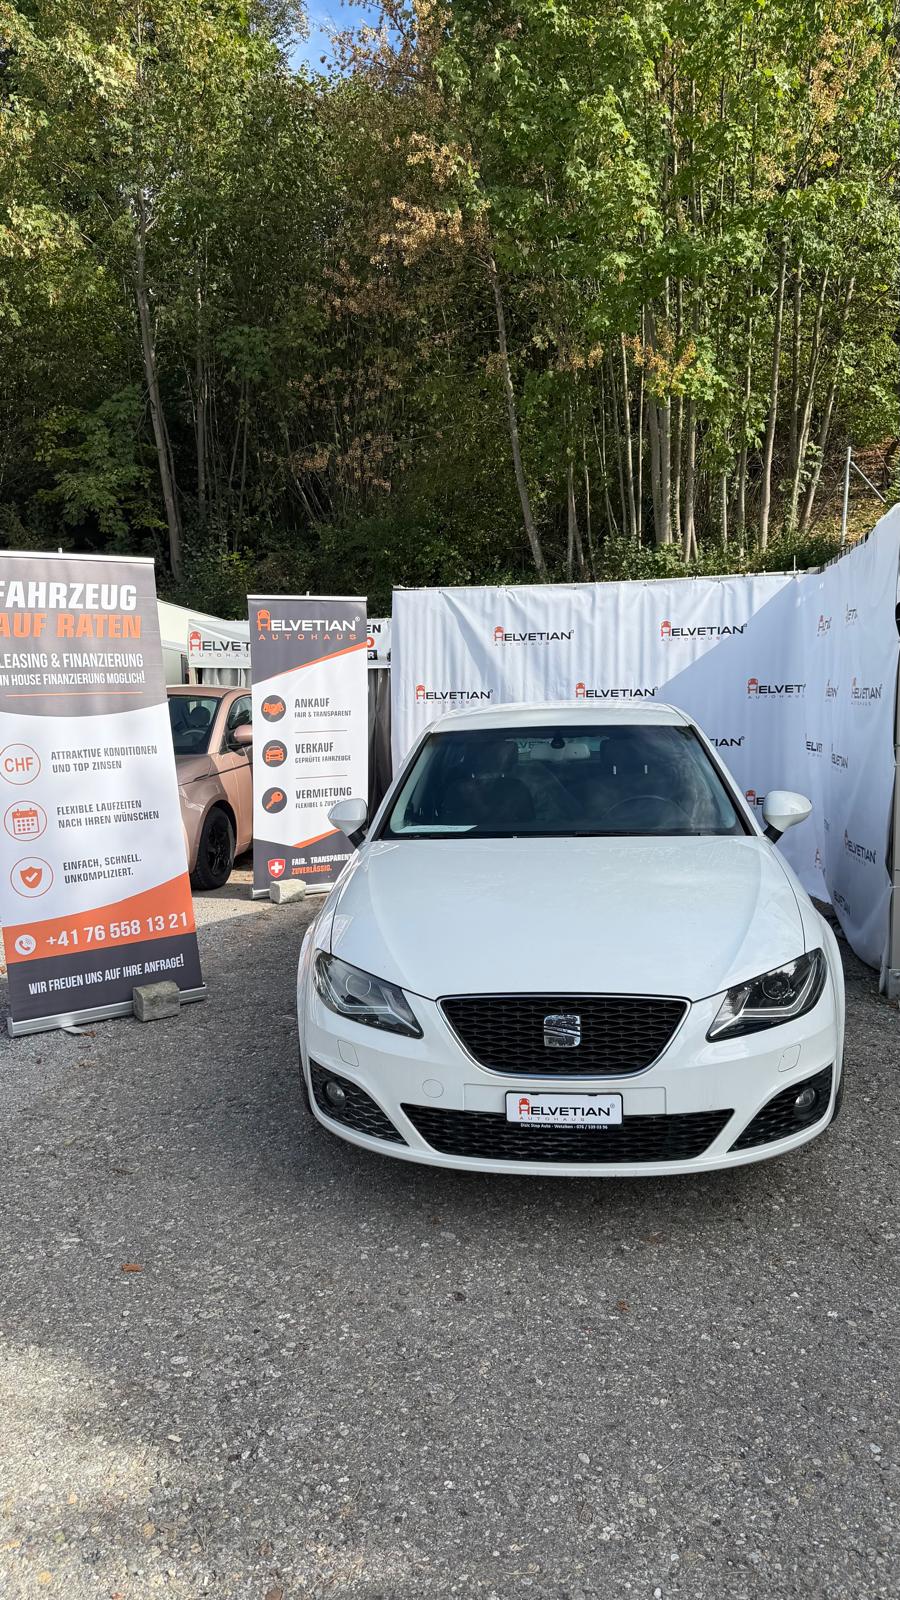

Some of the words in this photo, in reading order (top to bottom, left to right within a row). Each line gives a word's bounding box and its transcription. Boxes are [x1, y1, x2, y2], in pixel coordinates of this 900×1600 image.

[56, 613, 142, 639] RATEN
[189, 630, 251, 651] HELVET
[258, 633, 357, 641] AUTOHAUS
[51, 653, 60, 668] &
[63, 653, 144, 668] FINANZIERUNG
[11, 674, 41, 686] HOUSE
[43, 672, 105, 685] FINANZIERUNG
[294, 698, 330, 708] ANKAUF
[313, 710, 351, 718] TRANSPARENT
[51, 747, 101, 760] ATTRAKTIVE
[103, 745, 158, 757] KONDITIONEN
[295, 742, 334, 753] VERKAUF
[4, 757, 33, 773] CHF
[52, 764, 71, 773] UND
[73, 762, 90, 772] TOP
[92, 760, 122, 770] ZINSEN
[295, 756, 320, 764] GEPRÜFTE
[295, 787, 352, 799] VERMIETUNG
[57, 804, 94, 816] FLEXIBLE
[96, 800, 142, 812] LAUFZEITEN
[58, 818, 82, 828] NACH
[85, 815, 111, 826] IHREN
[113, 810, 160, 823] WÜNSCHEN
[63, 858, 102, 871] EINFACH,
[104, 854, 142, 866] SCHNELL.
[291, 858, 307, 866] FAIR.
[64, 867, 134, 884] UNKOMPLIZIERT.
[45, 929, 79, 947] +41
[84, 925, 106, 943] 76
[109, 919, 141, 939] 558
[146, 915, 165, 932] 13
[168, 911, 188, 930] 21
[28, 981, 47, 995] WIR
[48, 974, 84, 992] FREUEN
[85, 971, 103, 985] UNS
[104, 967, 121, 981] AUF
[122, 963, 143, 978] IHRE
[144, 953, 185, 974] ANFRAGE!
